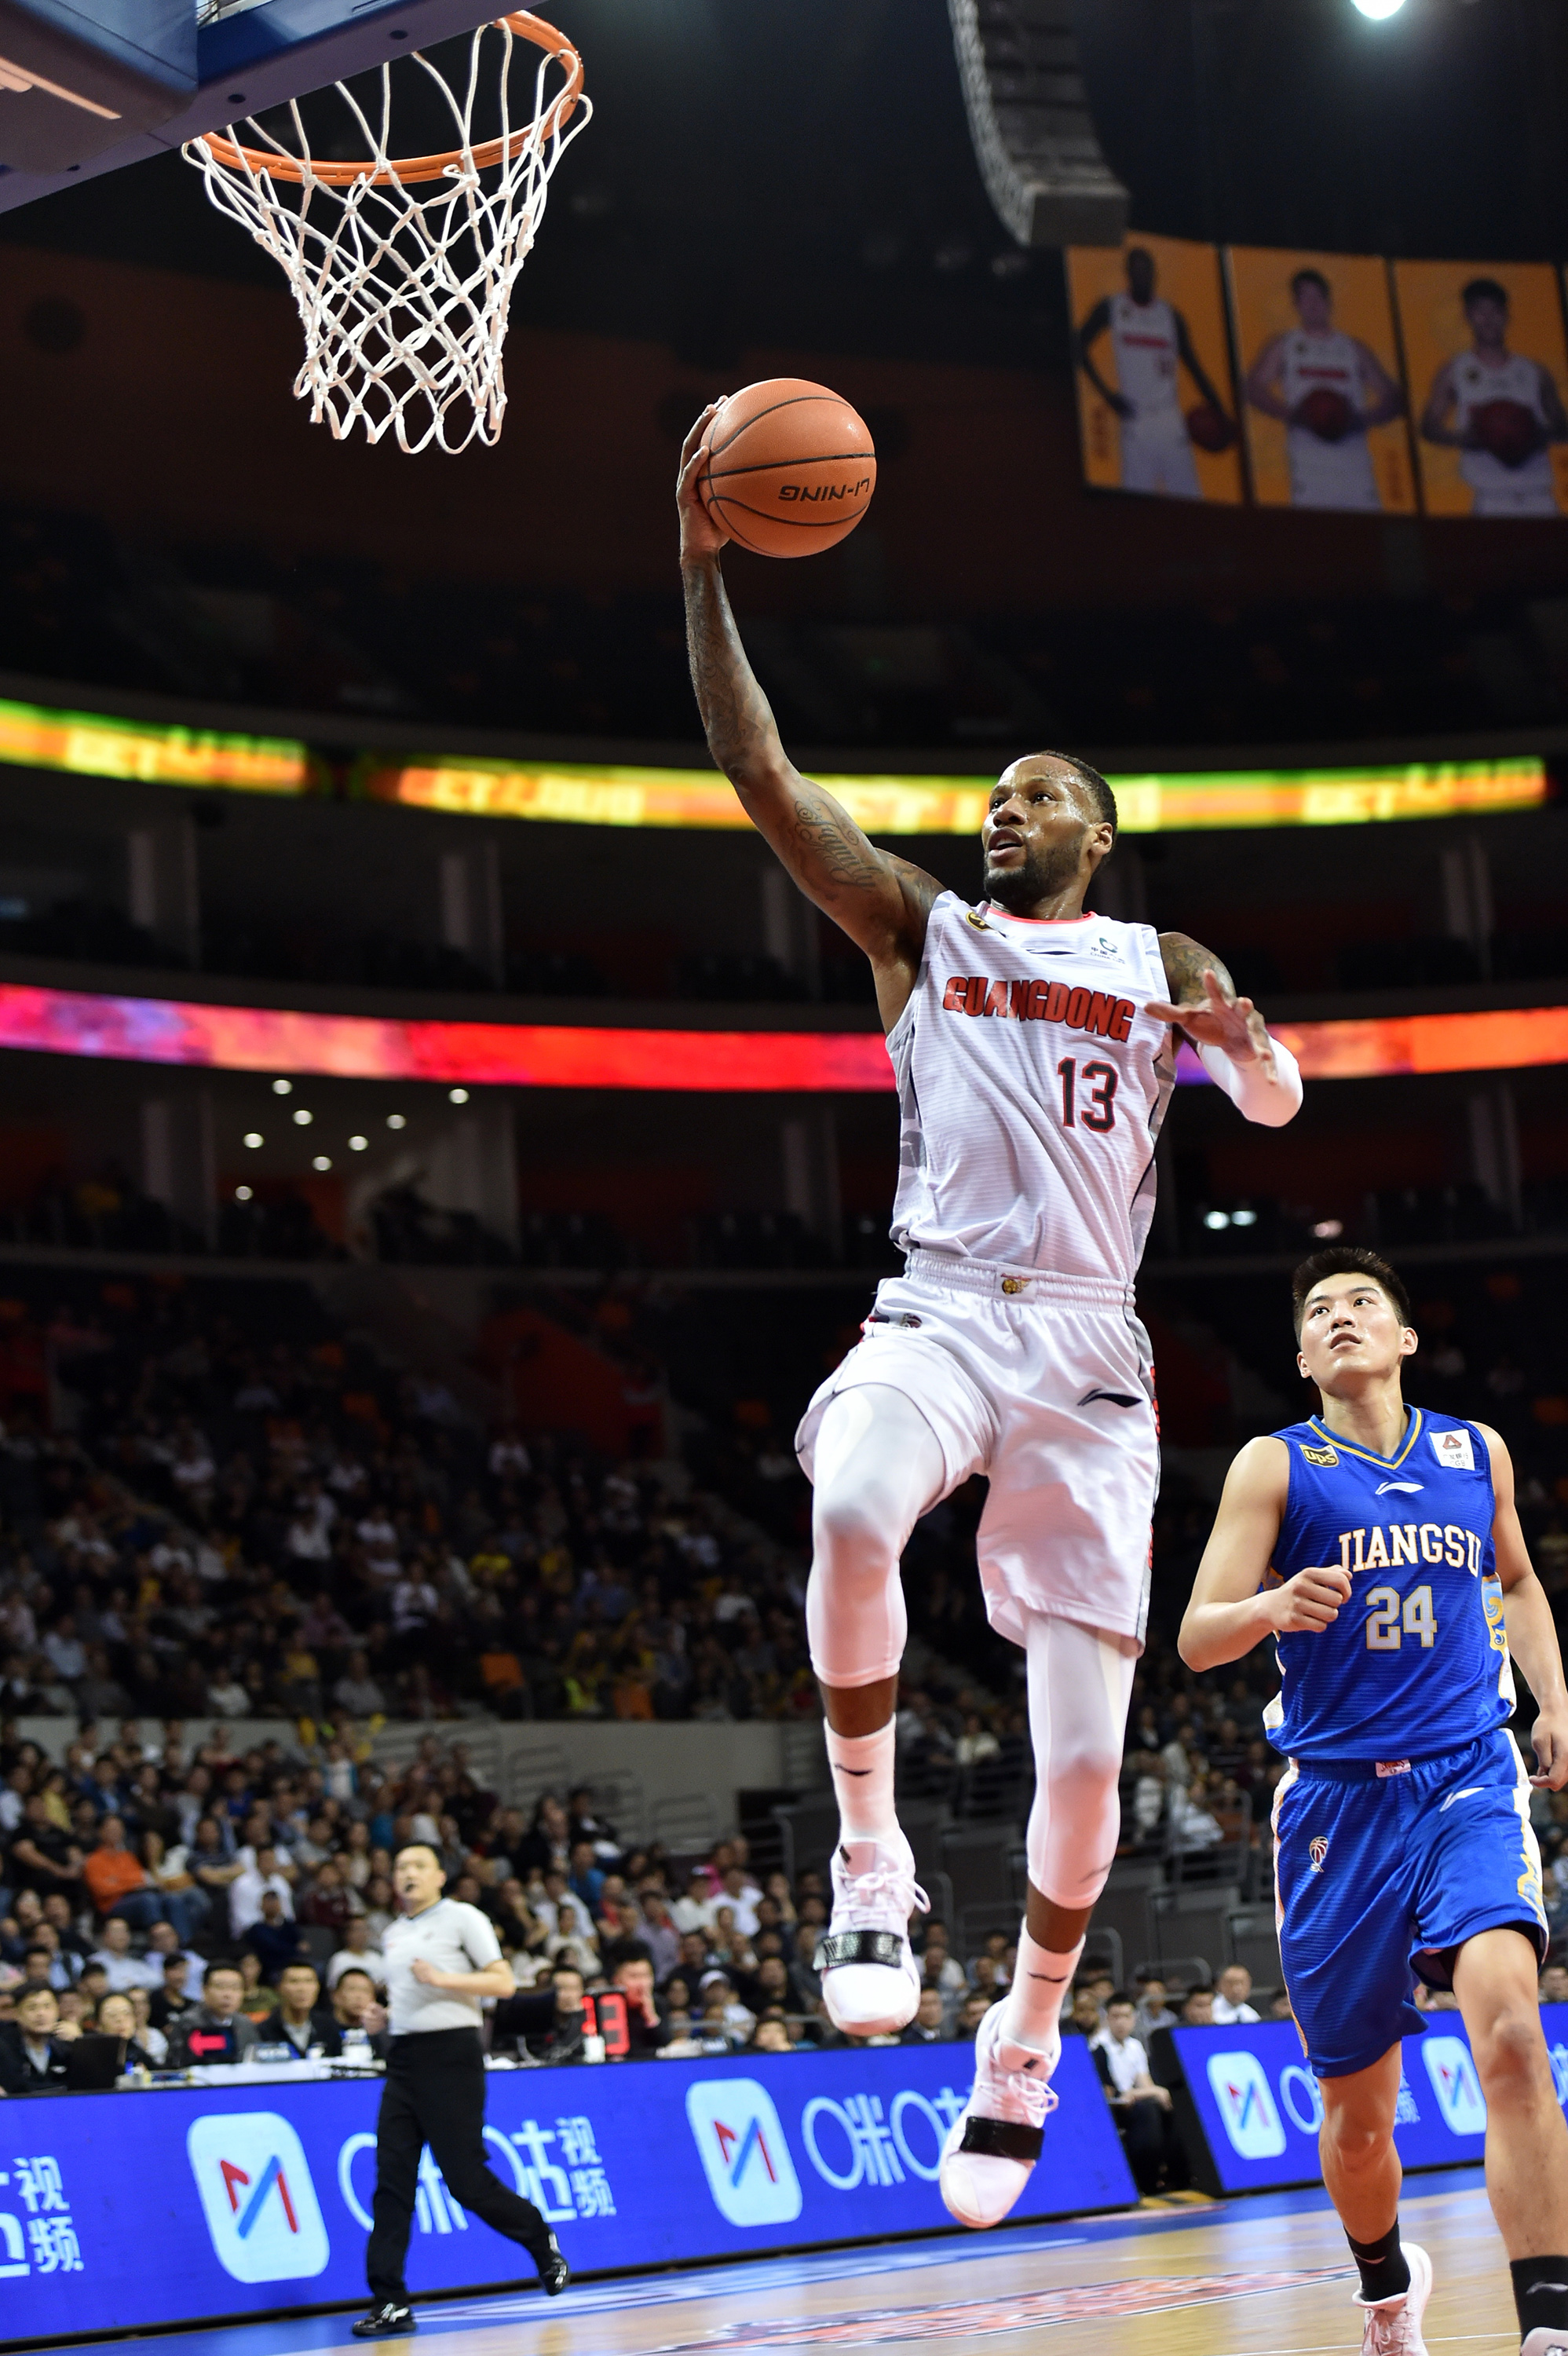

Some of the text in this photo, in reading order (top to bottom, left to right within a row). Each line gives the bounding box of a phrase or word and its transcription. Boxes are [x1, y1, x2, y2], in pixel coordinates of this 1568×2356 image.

[778, 477, 871, 502] LI-NING
[942, 976, 1135, 1042] GUANGDONG
[1058, 1056, 1119, 1133] 13
[1338, 1523, 1482, 1578] JIANGSU
[1365, 1585, 1438, 1650] 24
